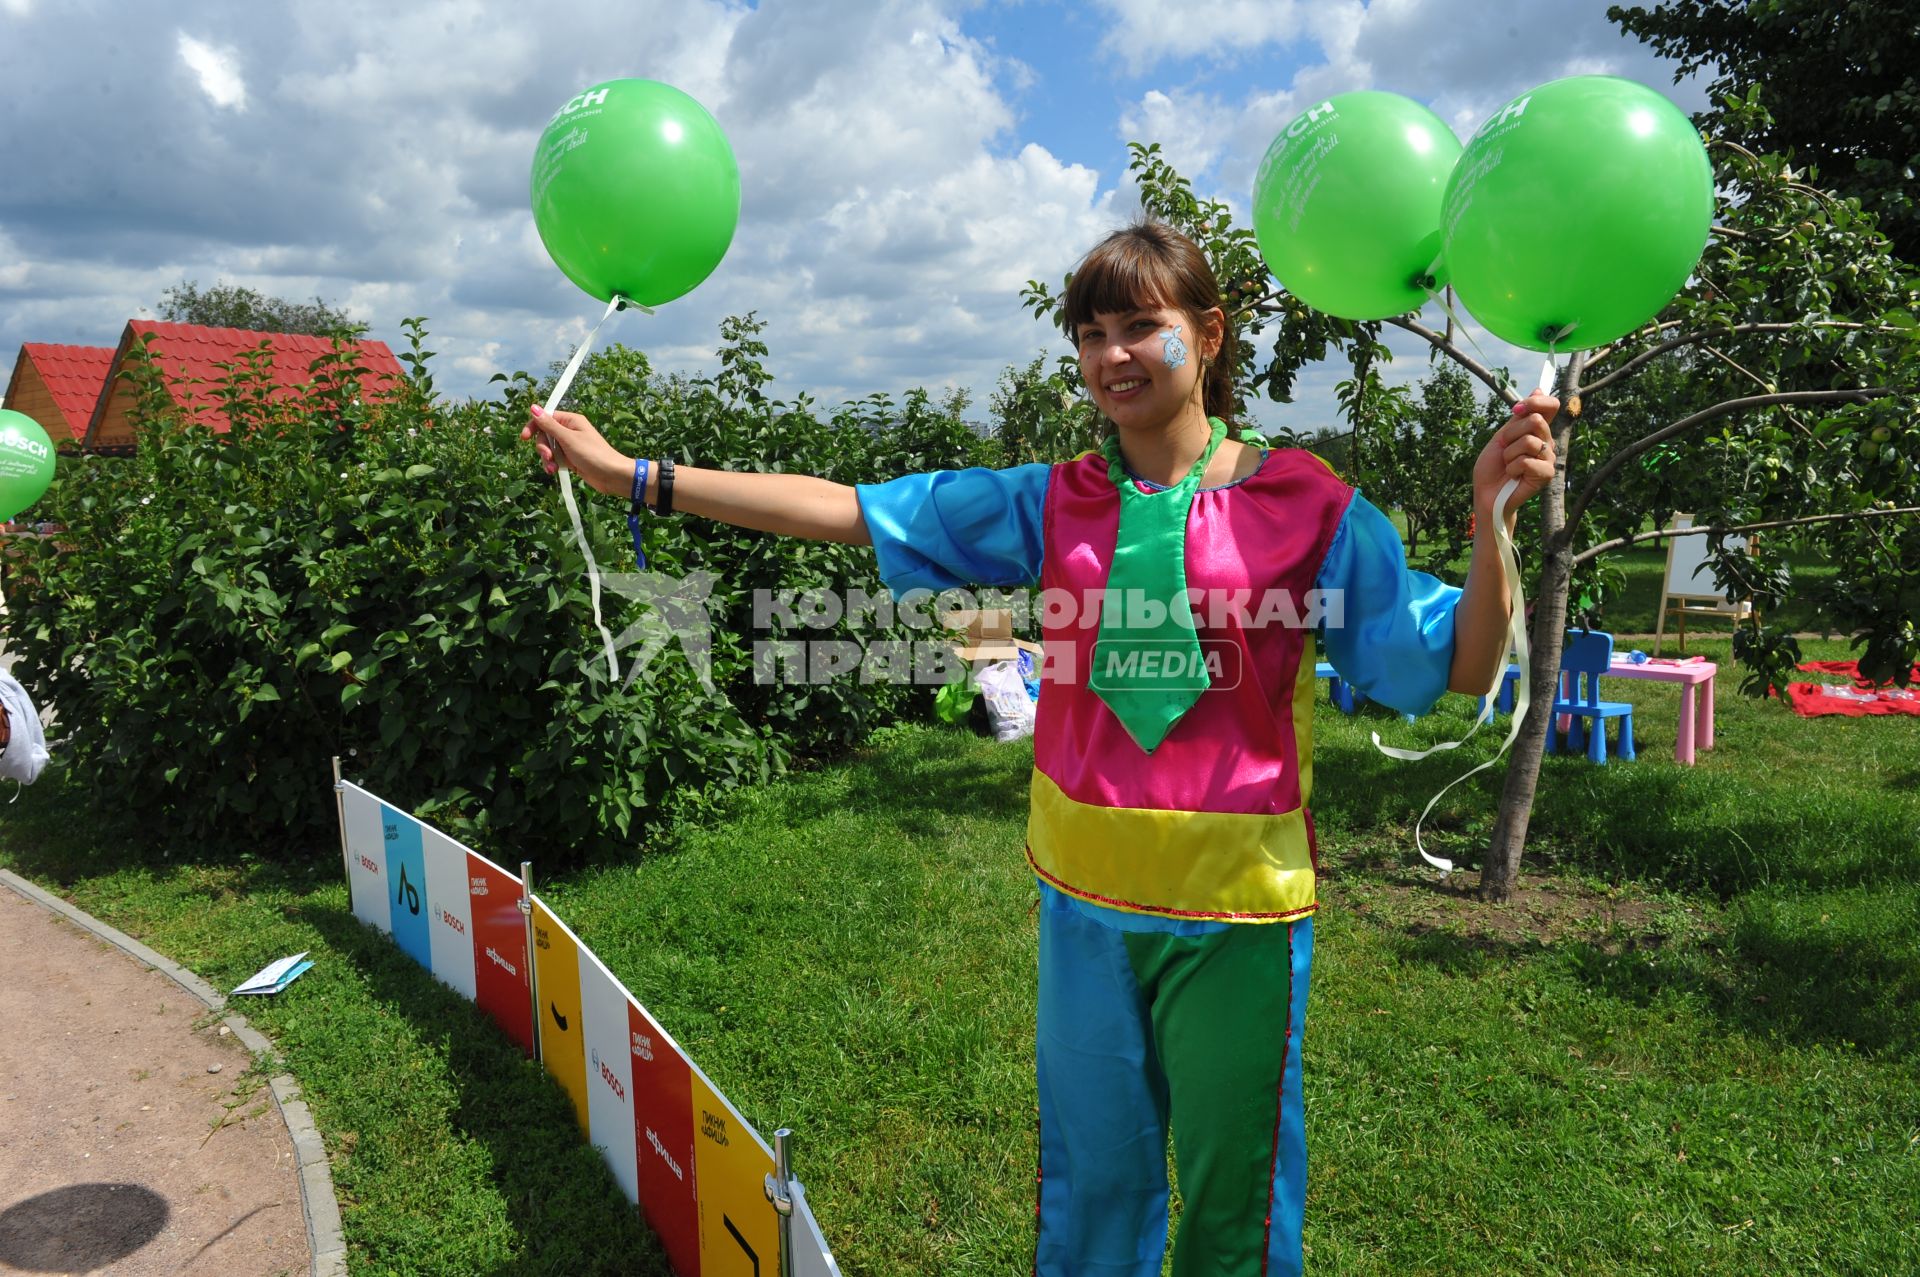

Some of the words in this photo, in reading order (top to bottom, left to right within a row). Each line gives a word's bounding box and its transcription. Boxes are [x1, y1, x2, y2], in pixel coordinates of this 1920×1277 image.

[361, 855, 379, 876] BOSCH
[443, 910, 465, 935] BOSCH
[485, 946, 516, 976] афиша
[601, 1062, 625, 1103] BOSCH
[702, 1109, 727, 1134] ПИКНИК
[645, 1126, 683, 1182] афиша
